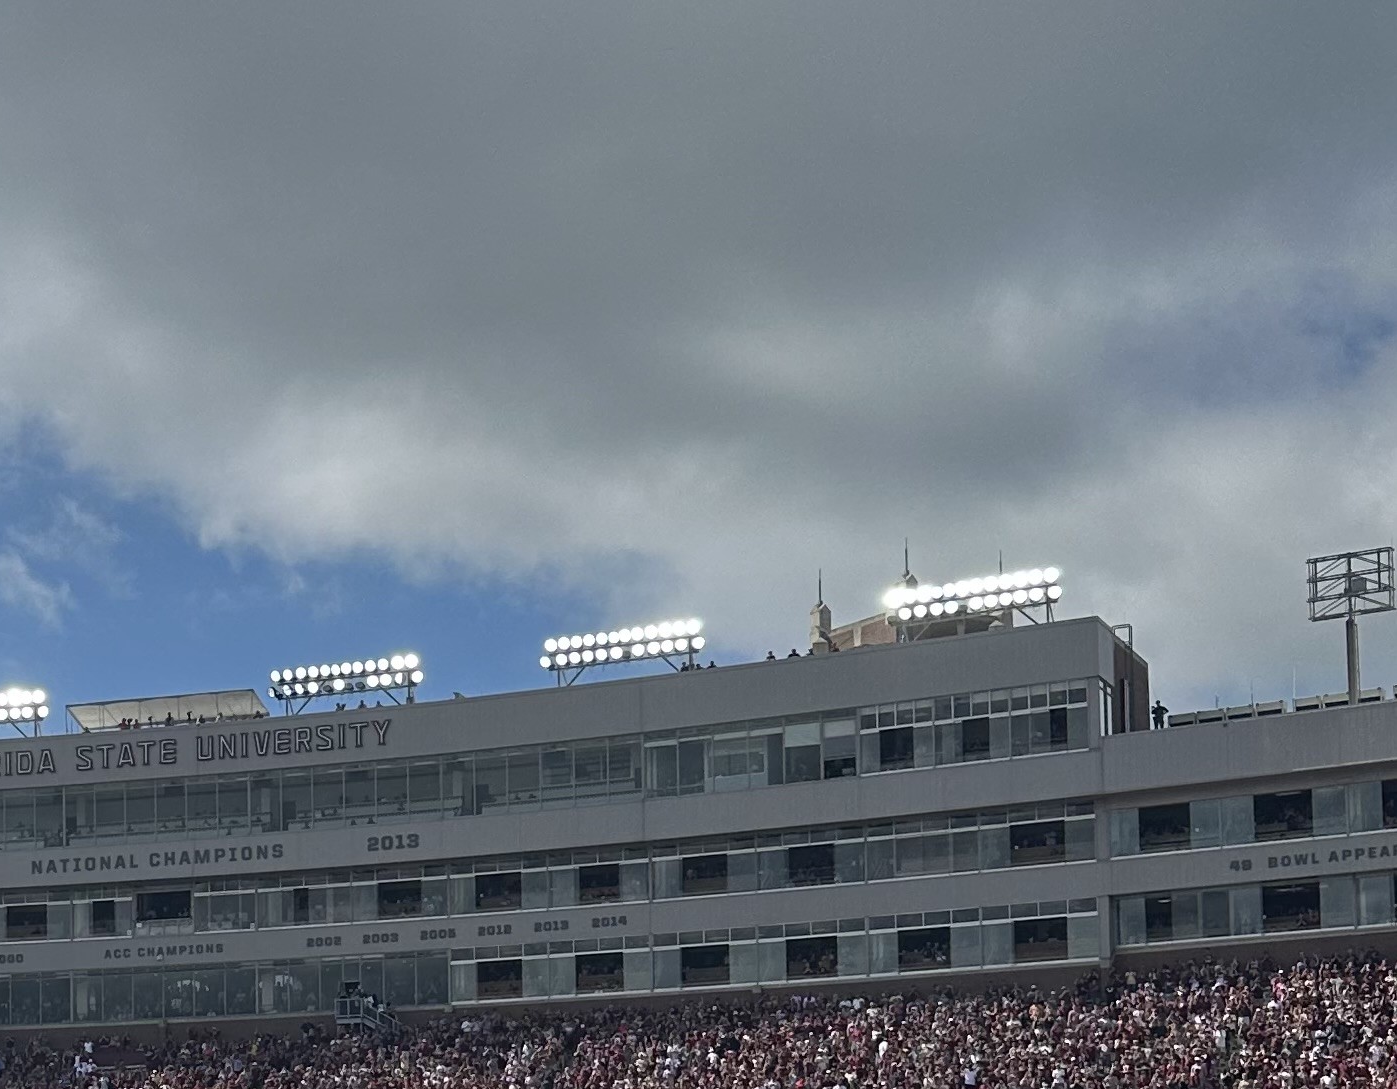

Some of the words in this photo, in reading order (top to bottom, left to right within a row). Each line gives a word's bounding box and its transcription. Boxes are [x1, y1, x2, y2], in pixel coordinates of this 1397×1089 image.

[75, 739, 178, 773] STATE
[196, 719, 392, 761] UNIVERSITY
[32, 855, 138, 874] NATIONAL
[150, 844, 283, 867] CHAMPIONS
[368, 834, 419, 851] 2013
[1268, 853, 1319, 868] BOWL
[104, 948, 131, 959] ACC
[137, 943, 224, 958] CHAMPIONS
[362, 932, 399, 945] 2003
[591, 915, 628, 929] 2014
